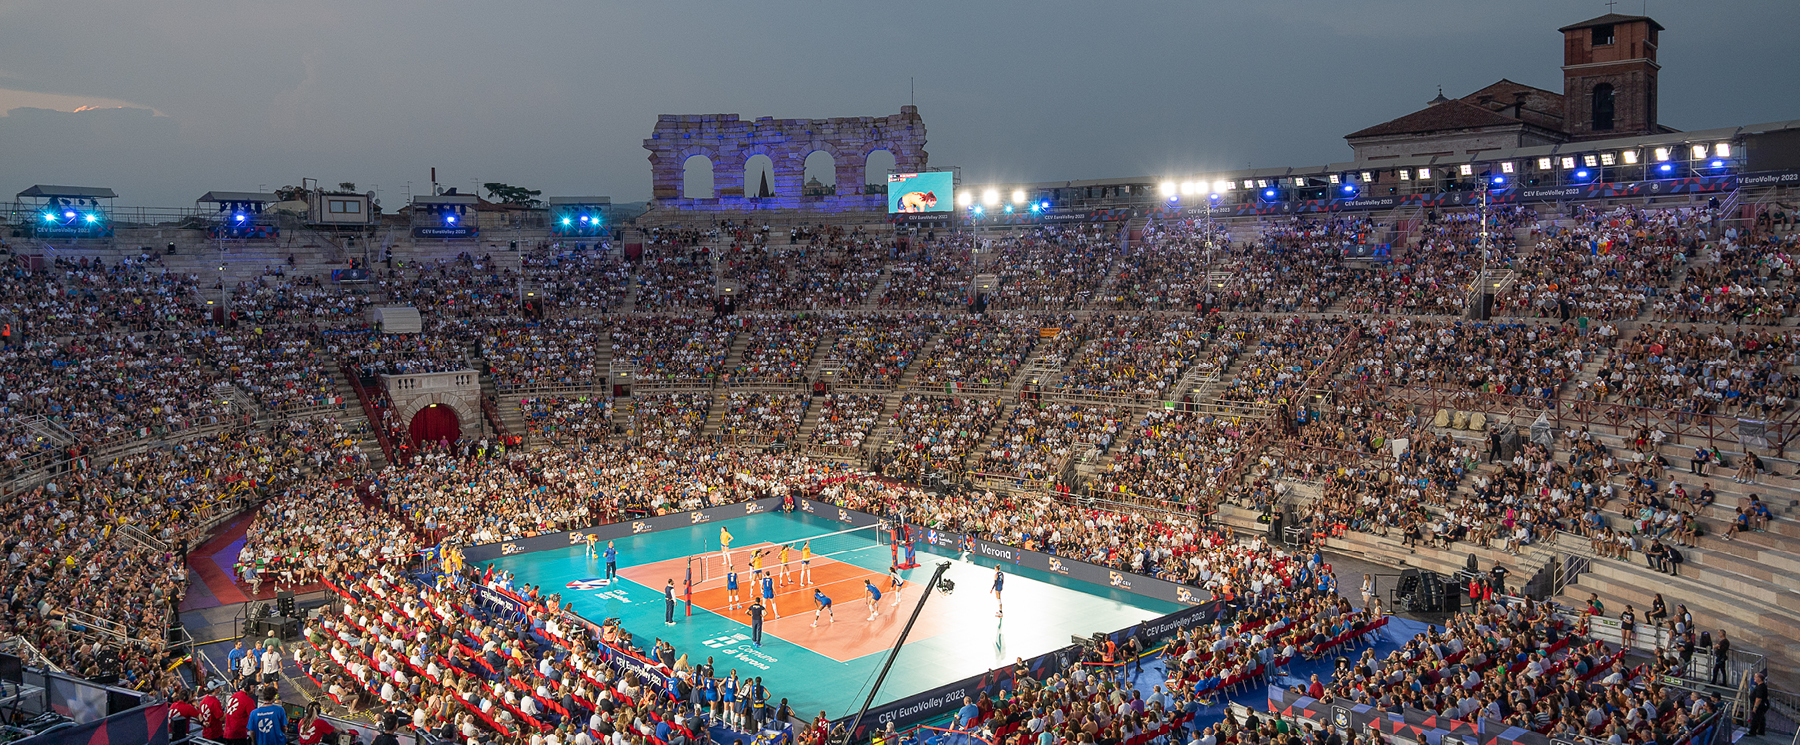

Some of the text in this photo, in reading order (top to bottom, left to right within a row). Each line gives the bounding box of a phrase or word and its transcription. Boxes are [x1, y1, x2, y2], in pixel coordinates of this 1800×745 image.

[980, 543, 1012, 560] Verona
[481, 590, 513, 611] CEV EuroVolley 2023
[1147, 611, 1206, 637] CEV EuroVolley 2023
[735, 653, 770, 670] Verona
[738, 645, 778, 662] Comune
[616, 656, 661, 686] CEV EuroVolley 2023
[878, 688, 965, 724] CEV EuroVolley 2023
